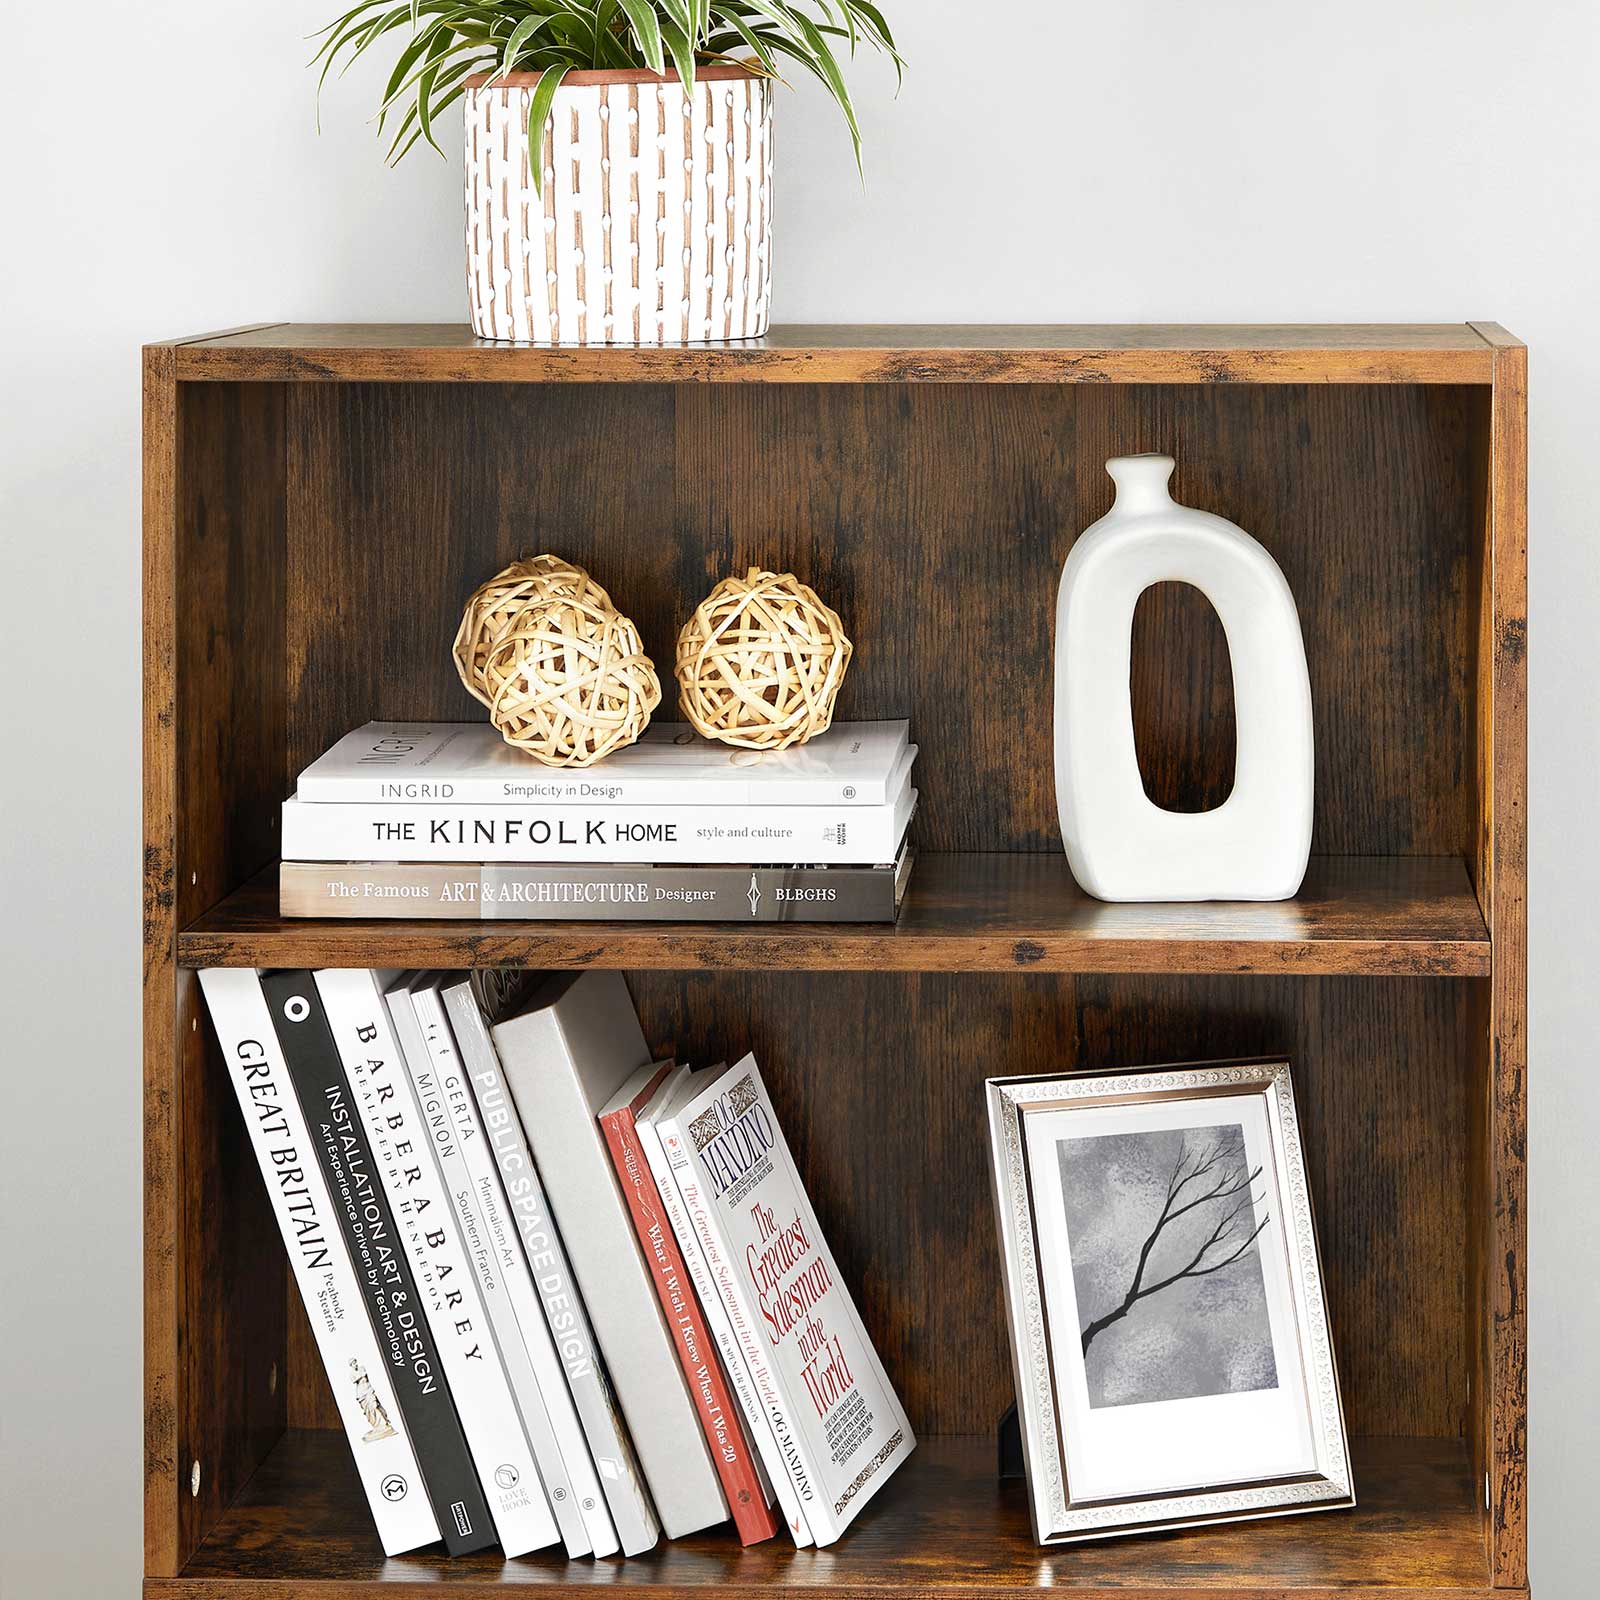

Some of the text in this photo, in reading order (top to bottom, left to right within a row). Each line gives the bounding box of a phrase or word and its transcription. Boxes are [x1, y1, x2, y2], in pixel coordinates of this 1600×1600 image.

[381, 783, 623, 799] INGRID Simplicity in Design
[373, 820, 793, 844] THE KINFOLK HOME style and culture
[327, 882, 836, 903] The Famous ART & ARCHITECTURE Designer BLBGHS
[713, 1093, 739, 1131] OG
[237, 1039, 333, 1269] GREAT BRITAIN
[445, 1076, 515, 1269] GERTA Minimalism Art
[697, 1102, 775, 1200] MANDINO
[354, 1065, 443, 1311] REALIZED BY HENREDON
[356, 1021, 482, 1362] BARBERA BAREY
[417, 1073, 496, 1291] MIGNON Southern France
[319, 1123, 406, 1368] Art Experience Driven by Technology
[324, 1085, 438, 1395] INSTALLATION ART & DESIGN
[475, 1070, 592, 1380] PUBLIC SPACE DESIGN
[648, 1222, 666, 1261] What
[660, 1177, 713, 1303] WHO MOVED MY CHEESE?
[751, 1202, 777, 1244] The
[661, 1264, 673, 1275] I
[746, 1208, 811, 1297] Greatest
[317, 1290, 336, 1333] Stearns
[323, 1272, 345, 1321] Peabody
[666, 1273, 682, 1313] Wish
[757, 1256, 833, 1345] Salesman
[679, 1315, 691, 1326] I
[685, 1184, 815, 1502] The Greatest Salesman in the World OG MANDINO
[795, 1314, 828, 1363] in the
[682, 1325, 700, 1364] Knew
[696, 1365, 714, 1407] When
[801, 1335, 854, 1419] World
[709, 1406, 721, 1417] I
[738, 1388, 761, 1424] JOHNSON
[710, 1416, 727, 1445] Was
[722, 1444, 737, 1464] 20
